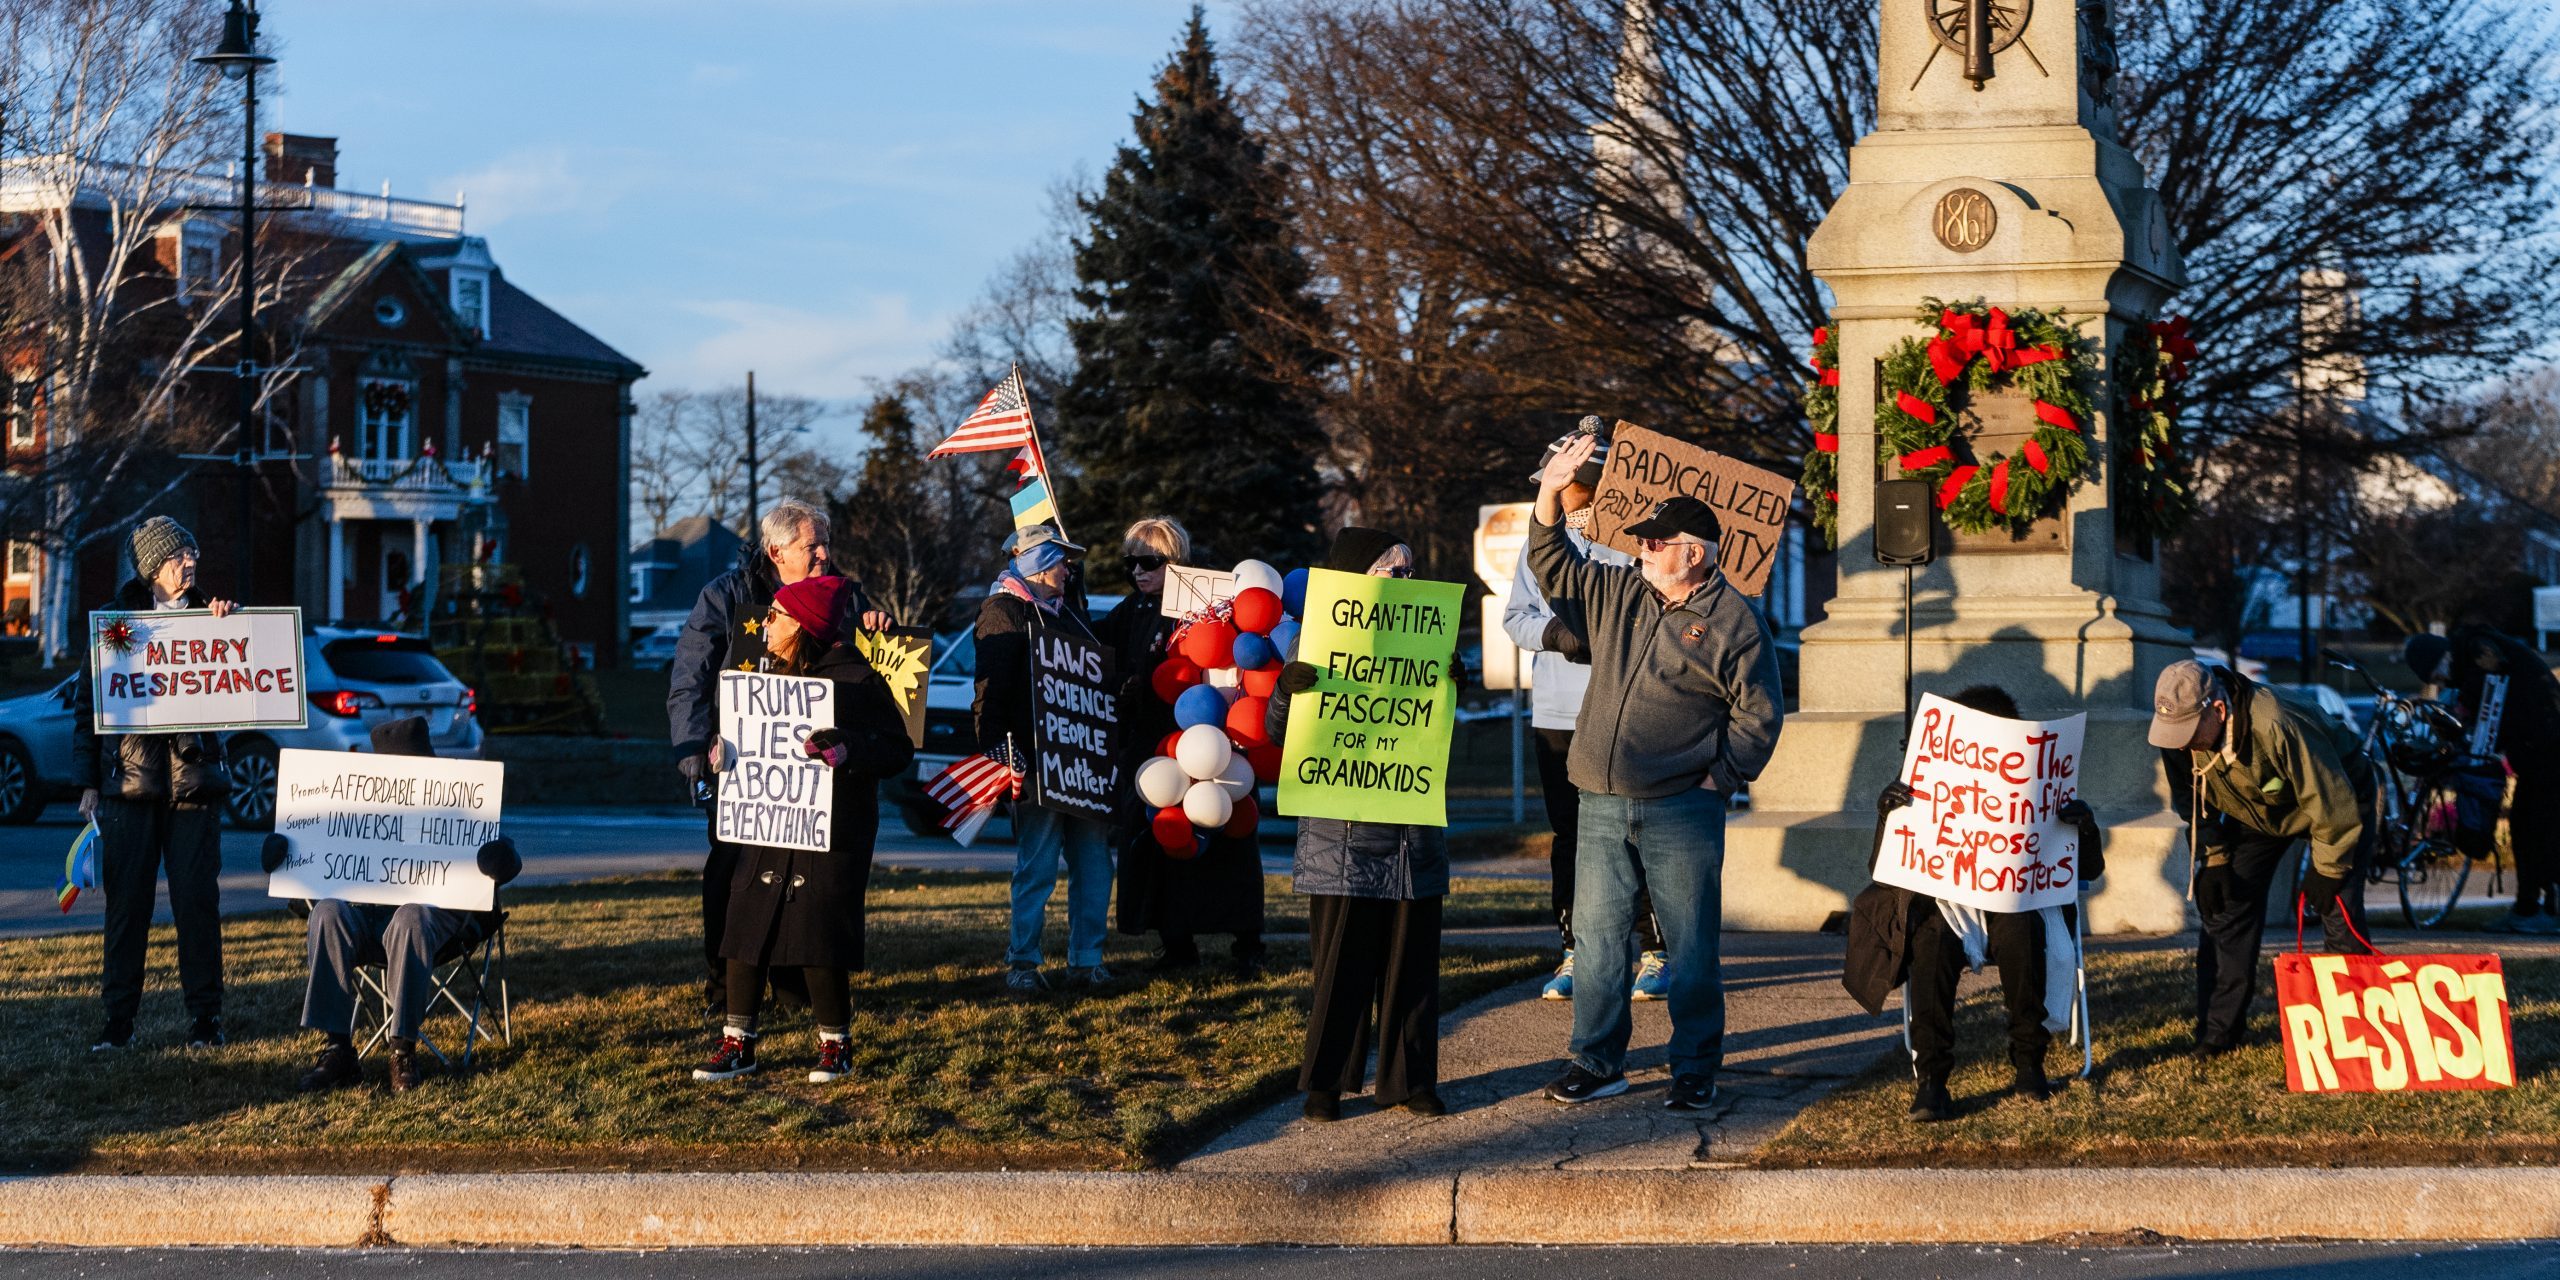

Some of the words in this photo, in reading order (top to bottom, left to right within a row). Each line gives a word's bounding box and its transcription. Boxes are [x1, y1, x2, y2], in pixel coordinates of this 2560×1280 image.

[1939, 194, 1987, 247] 1861
[1613, 440, 1787, 526] RADICALIZED
[1634, 487, 1653, 517] by
[1332, 598, 1446, 635] GRAN-TIFA:
[146, 637, 249, 666] MERRY
[867, 646, 905, 672] JOIN
[1039, 636, 1102, 683] LAWS
[1327, 651, 1440, 688] FIGHTING
[108, 667, 295, 699] RESISTANCE
[722, 675, 828, 718] TRUMP
[1043, 673, 1118, 723] SCIENCE
[1318, 691, 1434, 728] FASCISM
[738, 717, 813, 762] LIES
[1046, 711, 1108, 757] PEOPLE
[1333, 731, 1367, 749] FOR
[1376, 736, 1399, 751] MY
[1920, 708, 2031, 785] Release
[291, 778, 330, 802] Promote
[330, 774, 417, 806] AFFORDABLE
[423, 778, 484, 809] HOUSING
[721, 761, 830, 806] ABOUT
[1042, 751, 1119, 796] Matter!
[1298, 756, 1433, 795] GRANDKIDS
[286, 812, 321, 830] Support
[327, 811, 405, 843] UNIVERSAL
[420, 817, 501, 847] HEALTHCARE
[719, 800, 828, 849] EVERYTHING
[1936, 811, 2041, 863] Expose
[286, 851, 315, 871] Protect
[323, 852, 375, 883] SOCIAL
[380, 857, 452, 886] SECURITY
